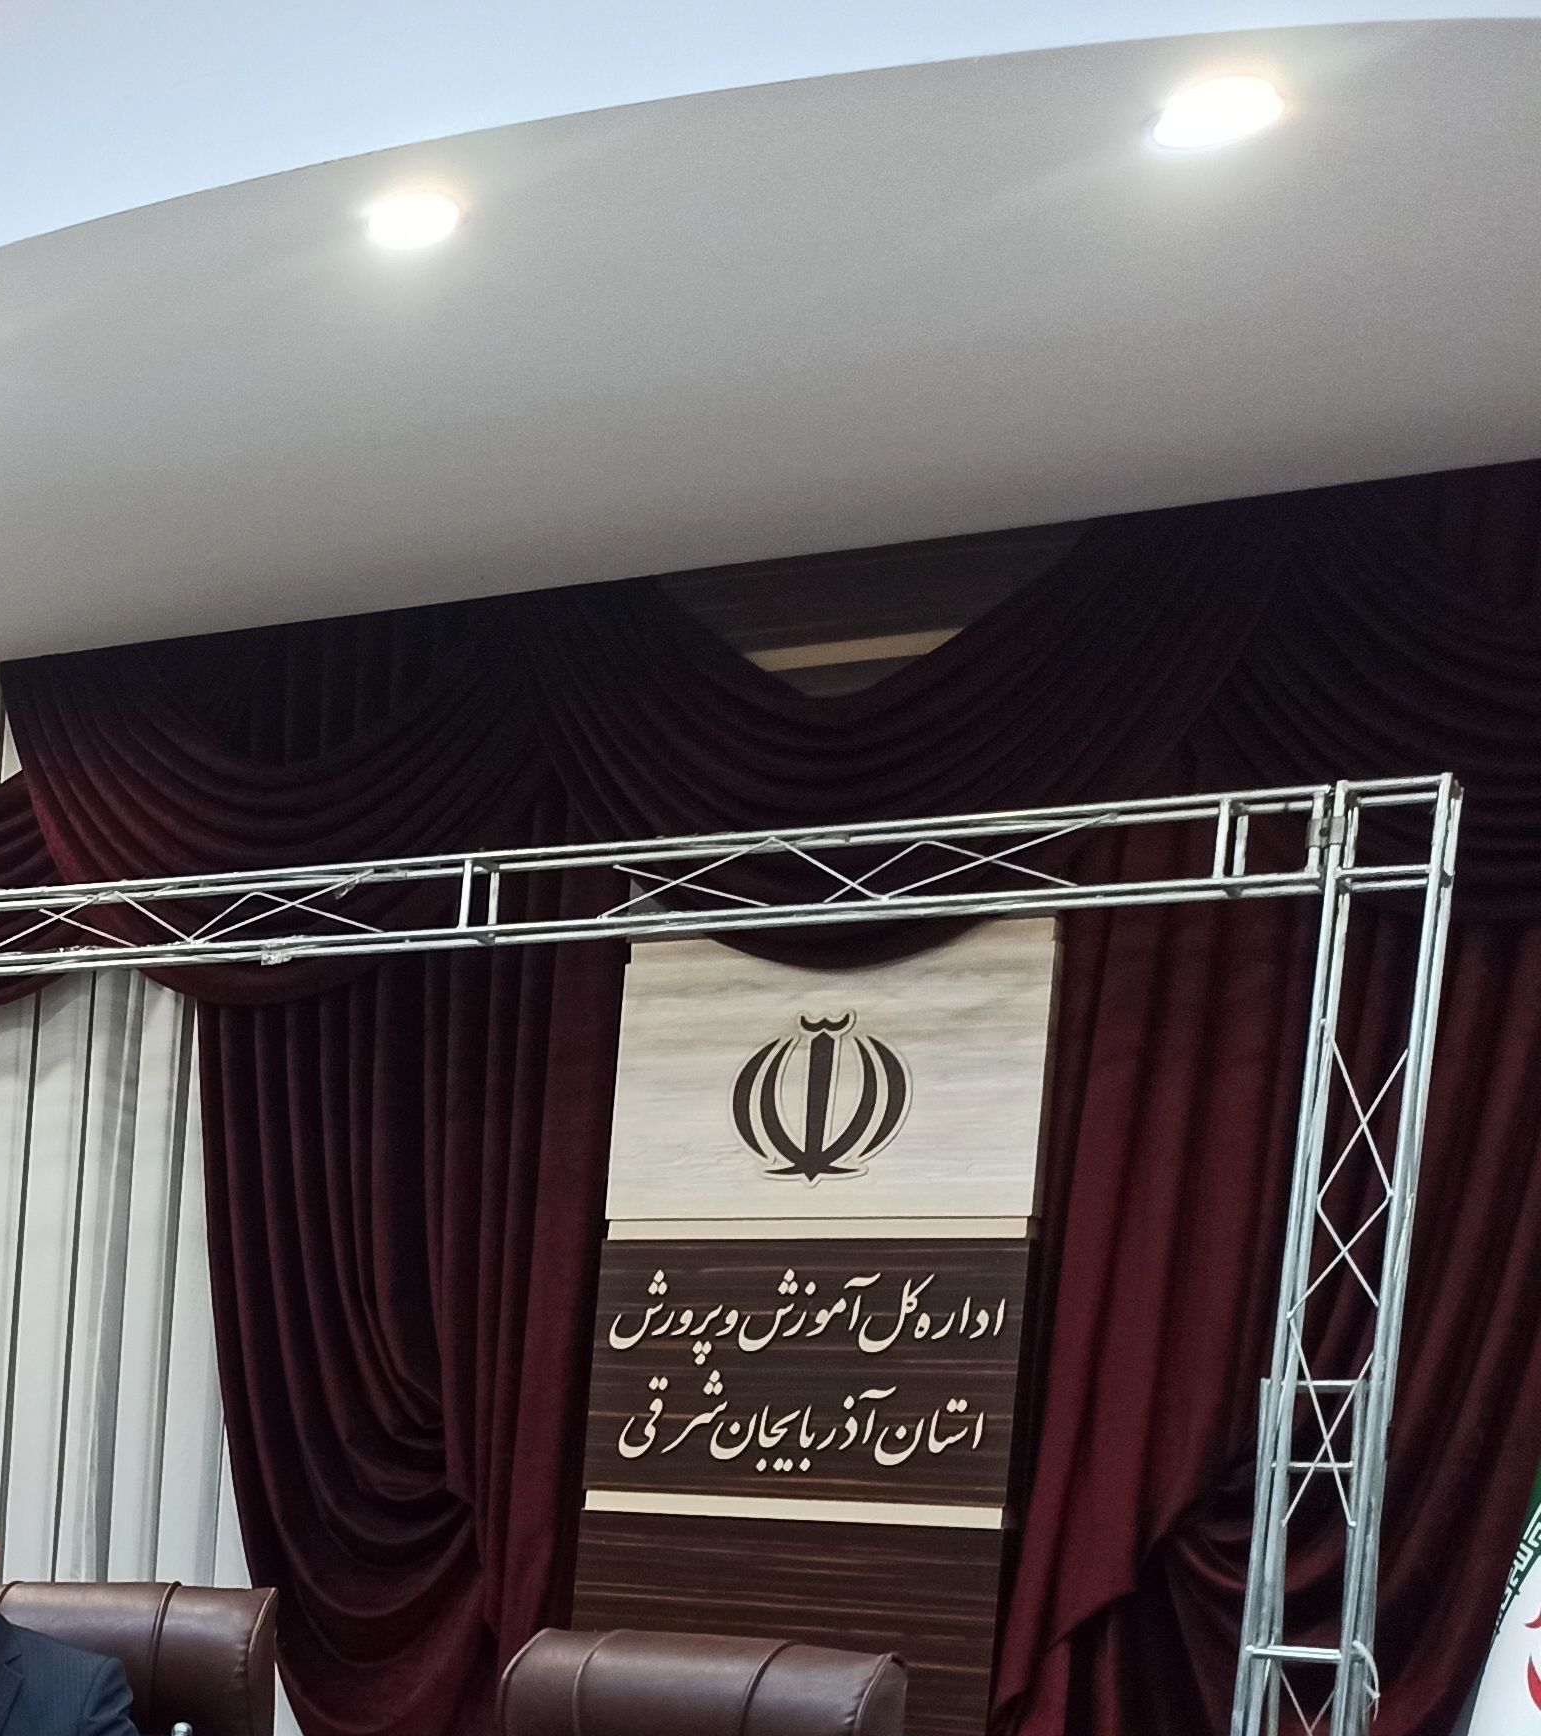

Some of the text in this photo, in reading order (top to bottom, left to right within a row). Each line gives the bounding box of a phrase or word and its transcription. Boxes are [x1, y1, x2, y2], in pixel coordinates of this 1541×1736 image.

[609, 1269, 723, 1365] پرورش
[738, 1268, 881, 1352] آموزش
[858, 1273, 935, 1353] کل
[914, 1296, 1005, 1340] اداره
[618, 1369, 984, 1472] استان آذربایجان شرقی
